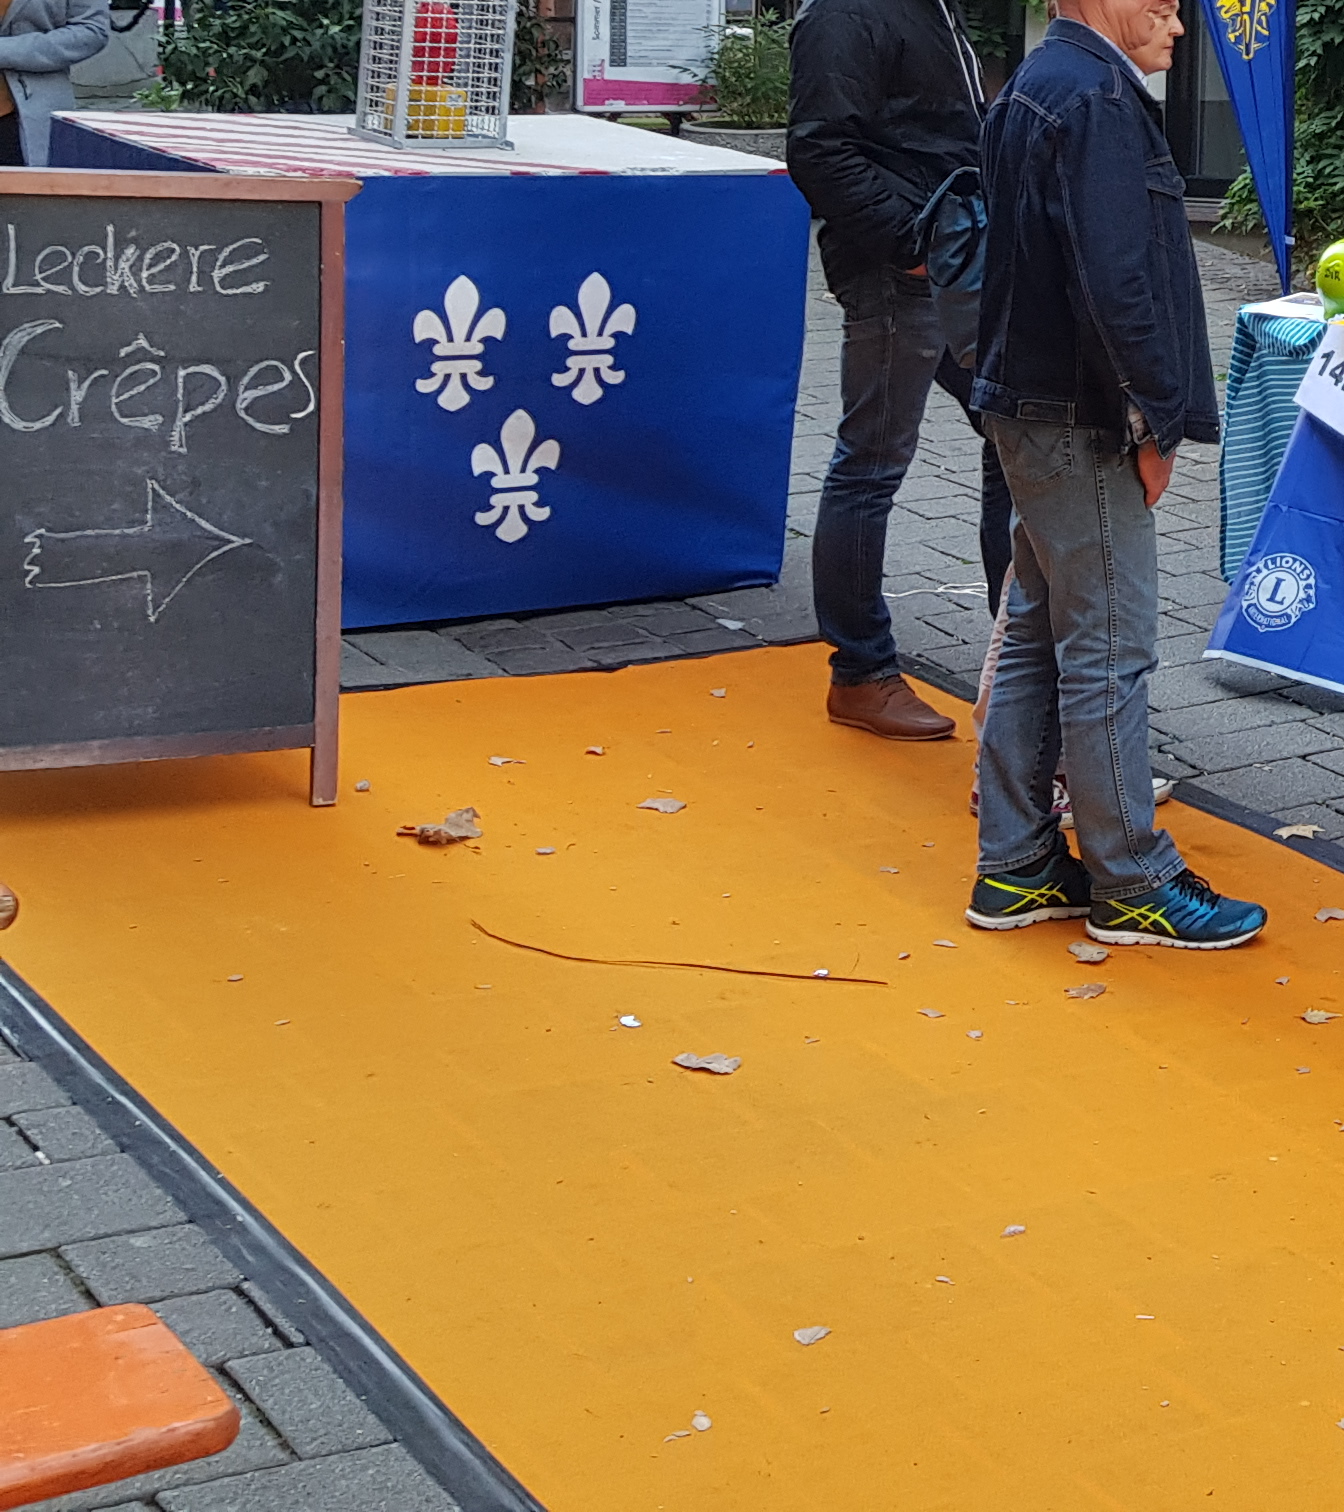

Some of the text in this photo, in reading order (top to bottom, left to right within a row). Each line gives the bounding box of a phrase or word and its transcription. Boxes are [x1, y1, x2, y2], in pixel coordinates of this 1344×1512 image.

[1, 223, 272, 299] Leckere
[0, 319, 318, 455] Crêpes
[1265, 576, 1287, 606] L
[1267, 555, 1312, 581] LIONS
